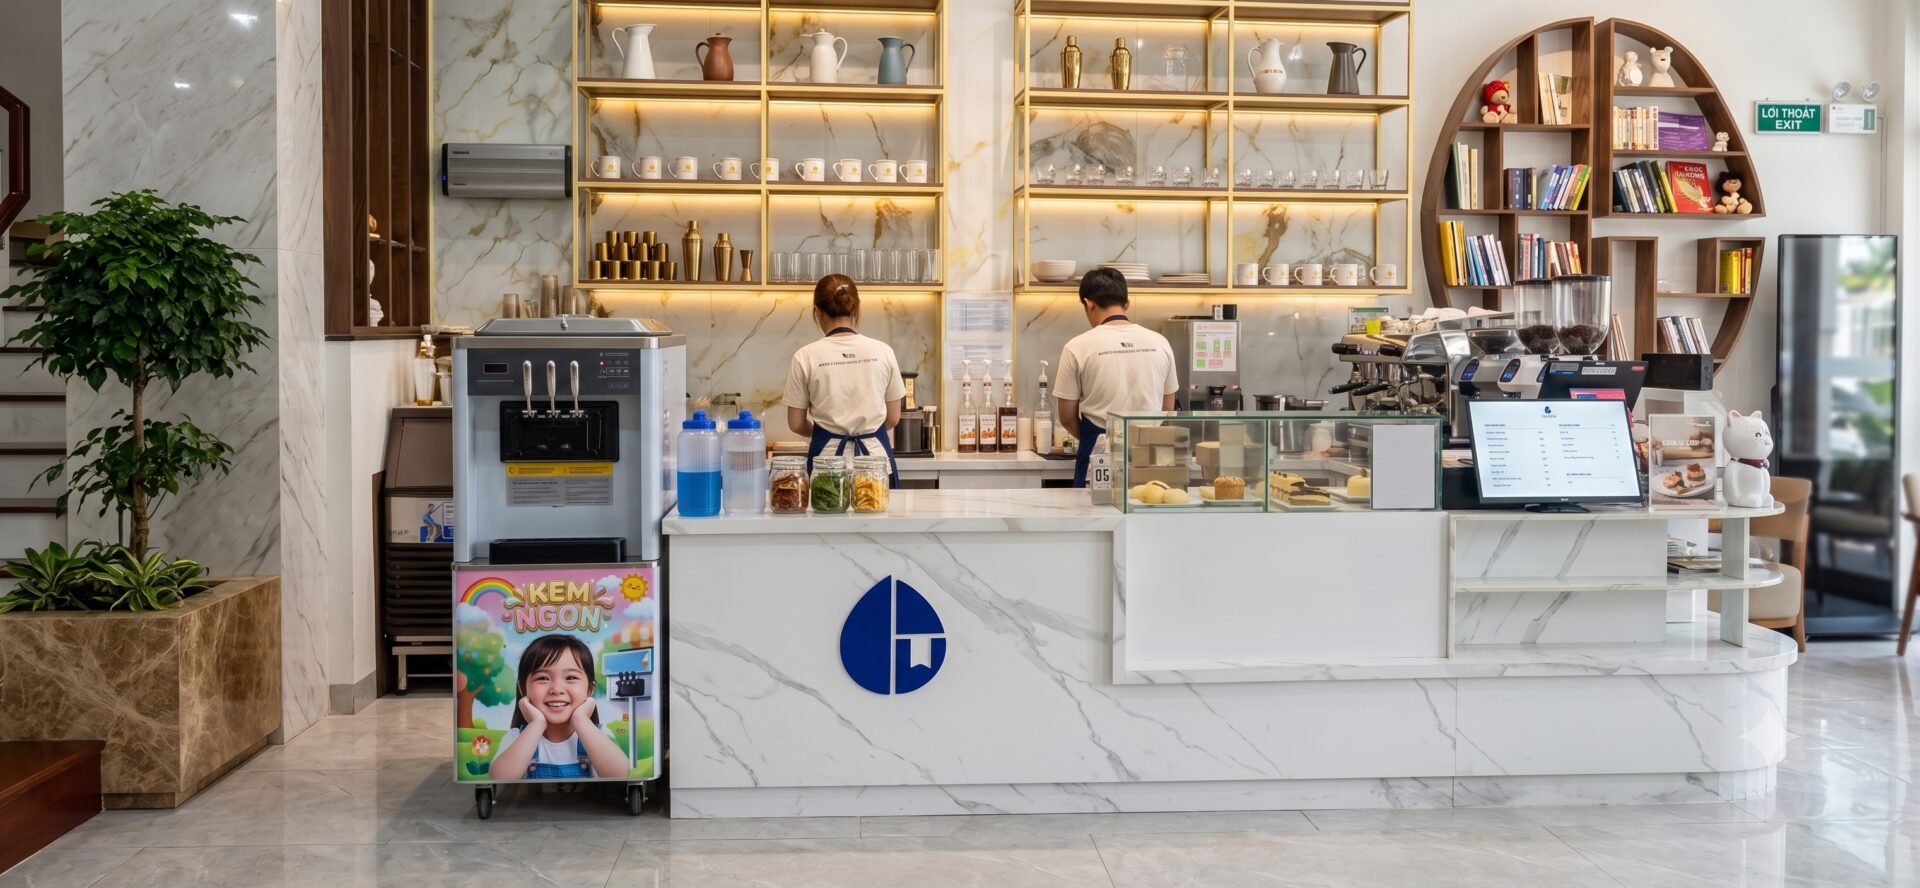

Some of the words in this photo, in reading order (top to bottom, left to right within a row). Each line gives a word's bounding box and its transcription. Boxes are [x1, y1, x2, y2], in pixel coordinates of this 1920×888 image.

[1781, 105, 1816, 119] THOÁT
[1775, 119, 1803, 130] EXIT
[1095, 468, 1110, 482] 05
[528, 581, 592, 605] KEM
[515, 605, 601, 632] NGON
